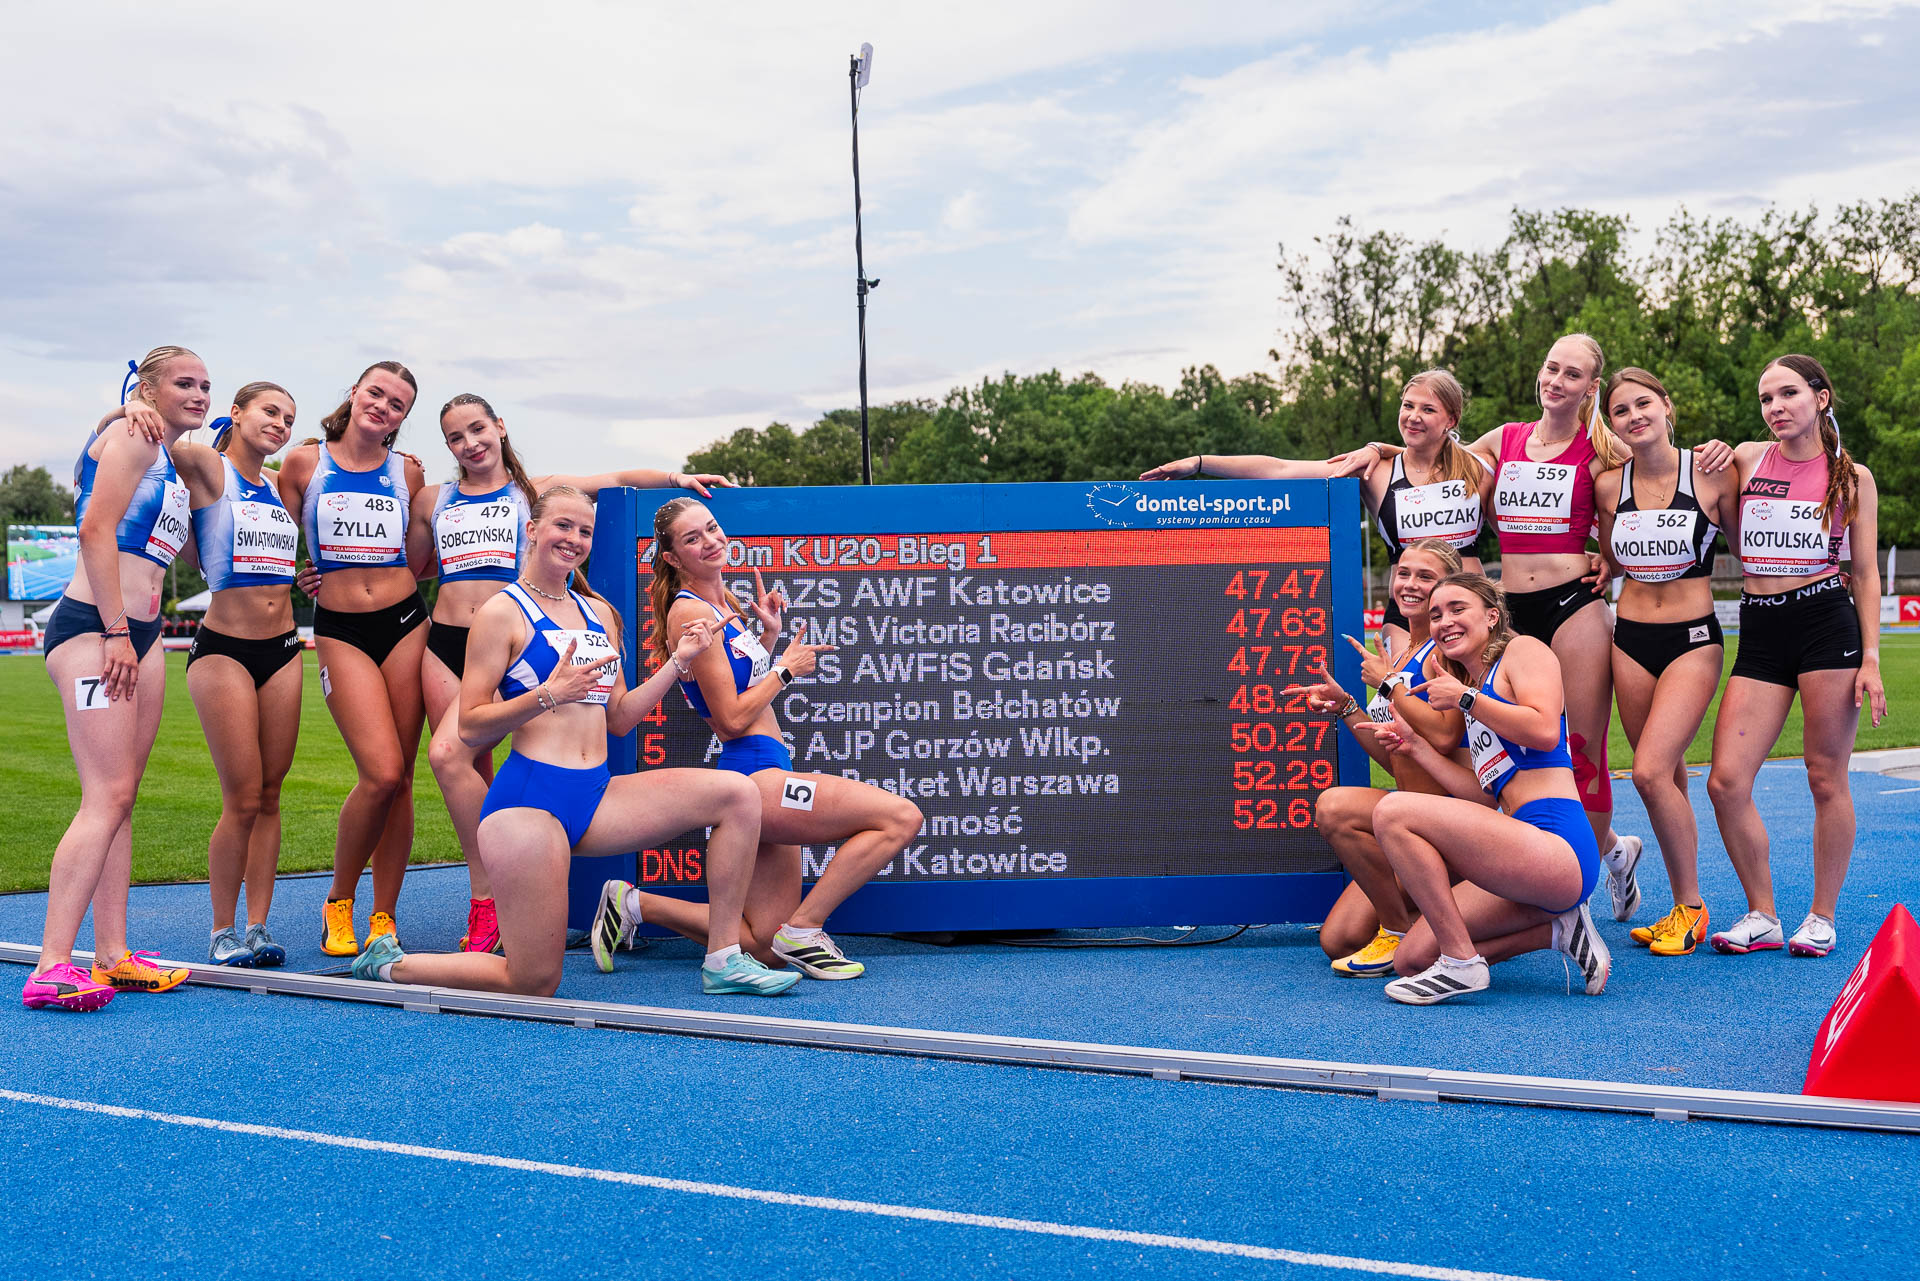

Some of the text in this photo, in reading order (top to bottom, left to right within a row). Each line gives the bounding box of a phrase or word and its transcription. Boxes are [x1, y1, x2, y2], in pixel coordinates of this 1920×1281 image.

[1536, 467, 1567, 481] 559
[1744, 481, 1790, 495] NIKE
[365, 498, 394, 512] 483
[1135, 494, 1291, 514] domtel-sport.pl
[1500, 491, 1564, 508] BAŁAZY
[271, 509, 291, 524] 481
[481, 505, 510, 518] 479
[1157, 515, 1196, 525] systemy
[1199, 515, 1240, 525] pomiaru
[1400, 507, 1476, 529] KUPCZAK
[1790, 505, 1823, 520] 560
[333, 517, 387, 538] ŻYLLA
[1657, 514, 1687, 528] 562
[237, 527, 295, 551] ŚWIĄTKOWSKA
[441, 526, 513, 550] SOBCZYŃSKA
[1744, 530, 1824, 549] KOTULSKA
[976, 535, 998, 563] 1
[1615, 539, 1690, 557] MOLENDA
[455, 558, 482, 569] ZAMOŚĆ
[1755, 564, 1809, 574] ZAMOŚĆ 2026
[1632, 572, 1660, 580] ZAMOŚĆ
[852, 576, 938, 607] AWF
[949, 576, 1111, 606] Katowice
[1224, 569, 1324, 600] 47.47
[1796, 576, 1840, 600] NIKE
[867, 615, 980, 645] Victoria
[990, 612, 1115, 643] Racibórz
[1225, 607, 1327, 638] 47.63
[284, 635, 299, 648] NIK
[584, 634, 609, 648] 523
[852, 652, 973, 683] AWFiS
[983, 650, 1115, 681] Gdańsk
[1227, 644, 1328, 676] 47.73
[82, 679, 100, 707] 7
[784, 692, 940, 729] Czempion
[953, 689, 1121, 720] Bełchatów
[1371, 705, 1393, 723] BISKU
[642, 733, 666, 765] 5
[804, 730, 875, 761] AJP
[885, 729, 1012, 760] Gorzów
[1019, 726, 1110, 764] Wlkp.
[1230, 721, 1330, 752] 50.27
[956, 766, 1119, 797] Warszawa
[1233, 760, 1333, 791] 52.29
[1484, 768, 1499, 781] 2026
[785, 784, 812, 803] 5
[918, 798, 1319, 836] mość 52.6
[642, 849, 702, 882] DNS
[903, 845, 1068, 876] Katowice
[107, 976, 160, 989] NITRO
